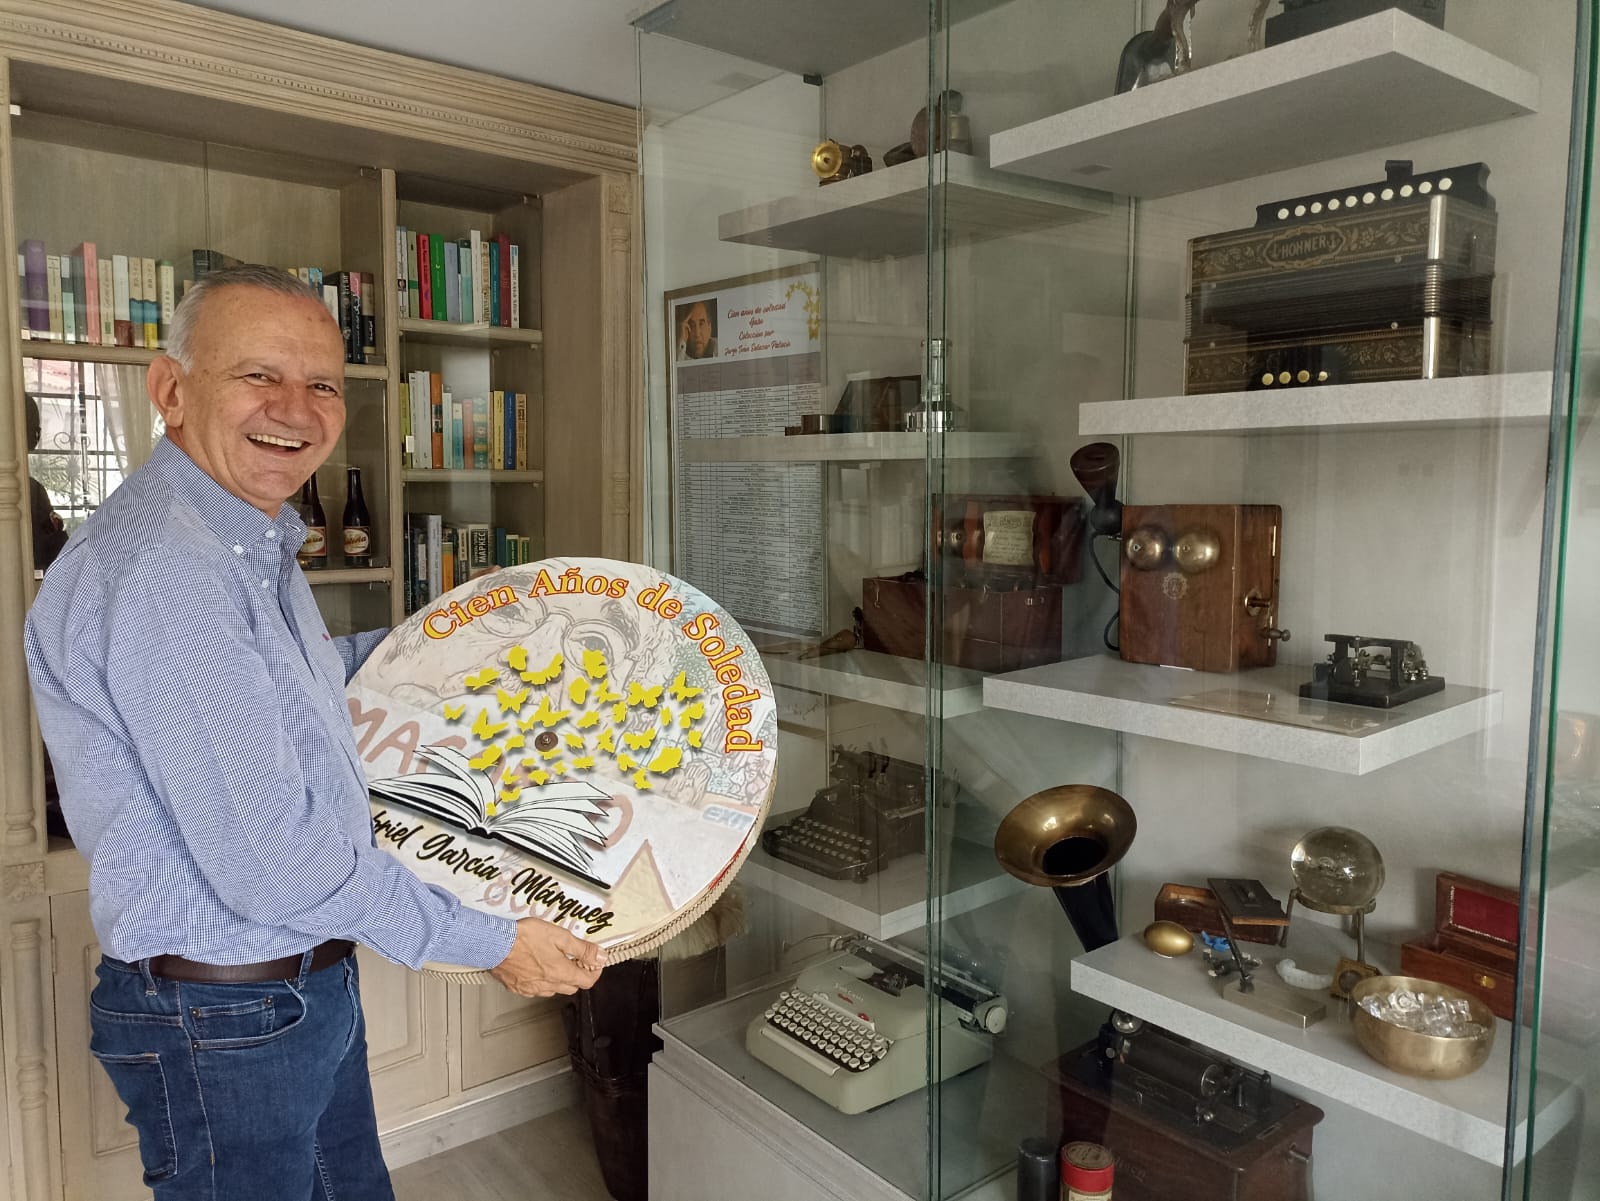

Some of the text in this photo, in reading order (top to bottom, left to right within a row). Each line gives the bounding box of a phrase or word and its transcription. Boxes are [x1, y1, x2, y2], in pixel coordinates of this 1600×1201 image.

[1281, 234, 1327, 260] HOHNER
[422, 567, 763, 753] Cien Años de Soledad
[416, 832, 502, 881] García
[510, 867, 616, 935] Márquez
